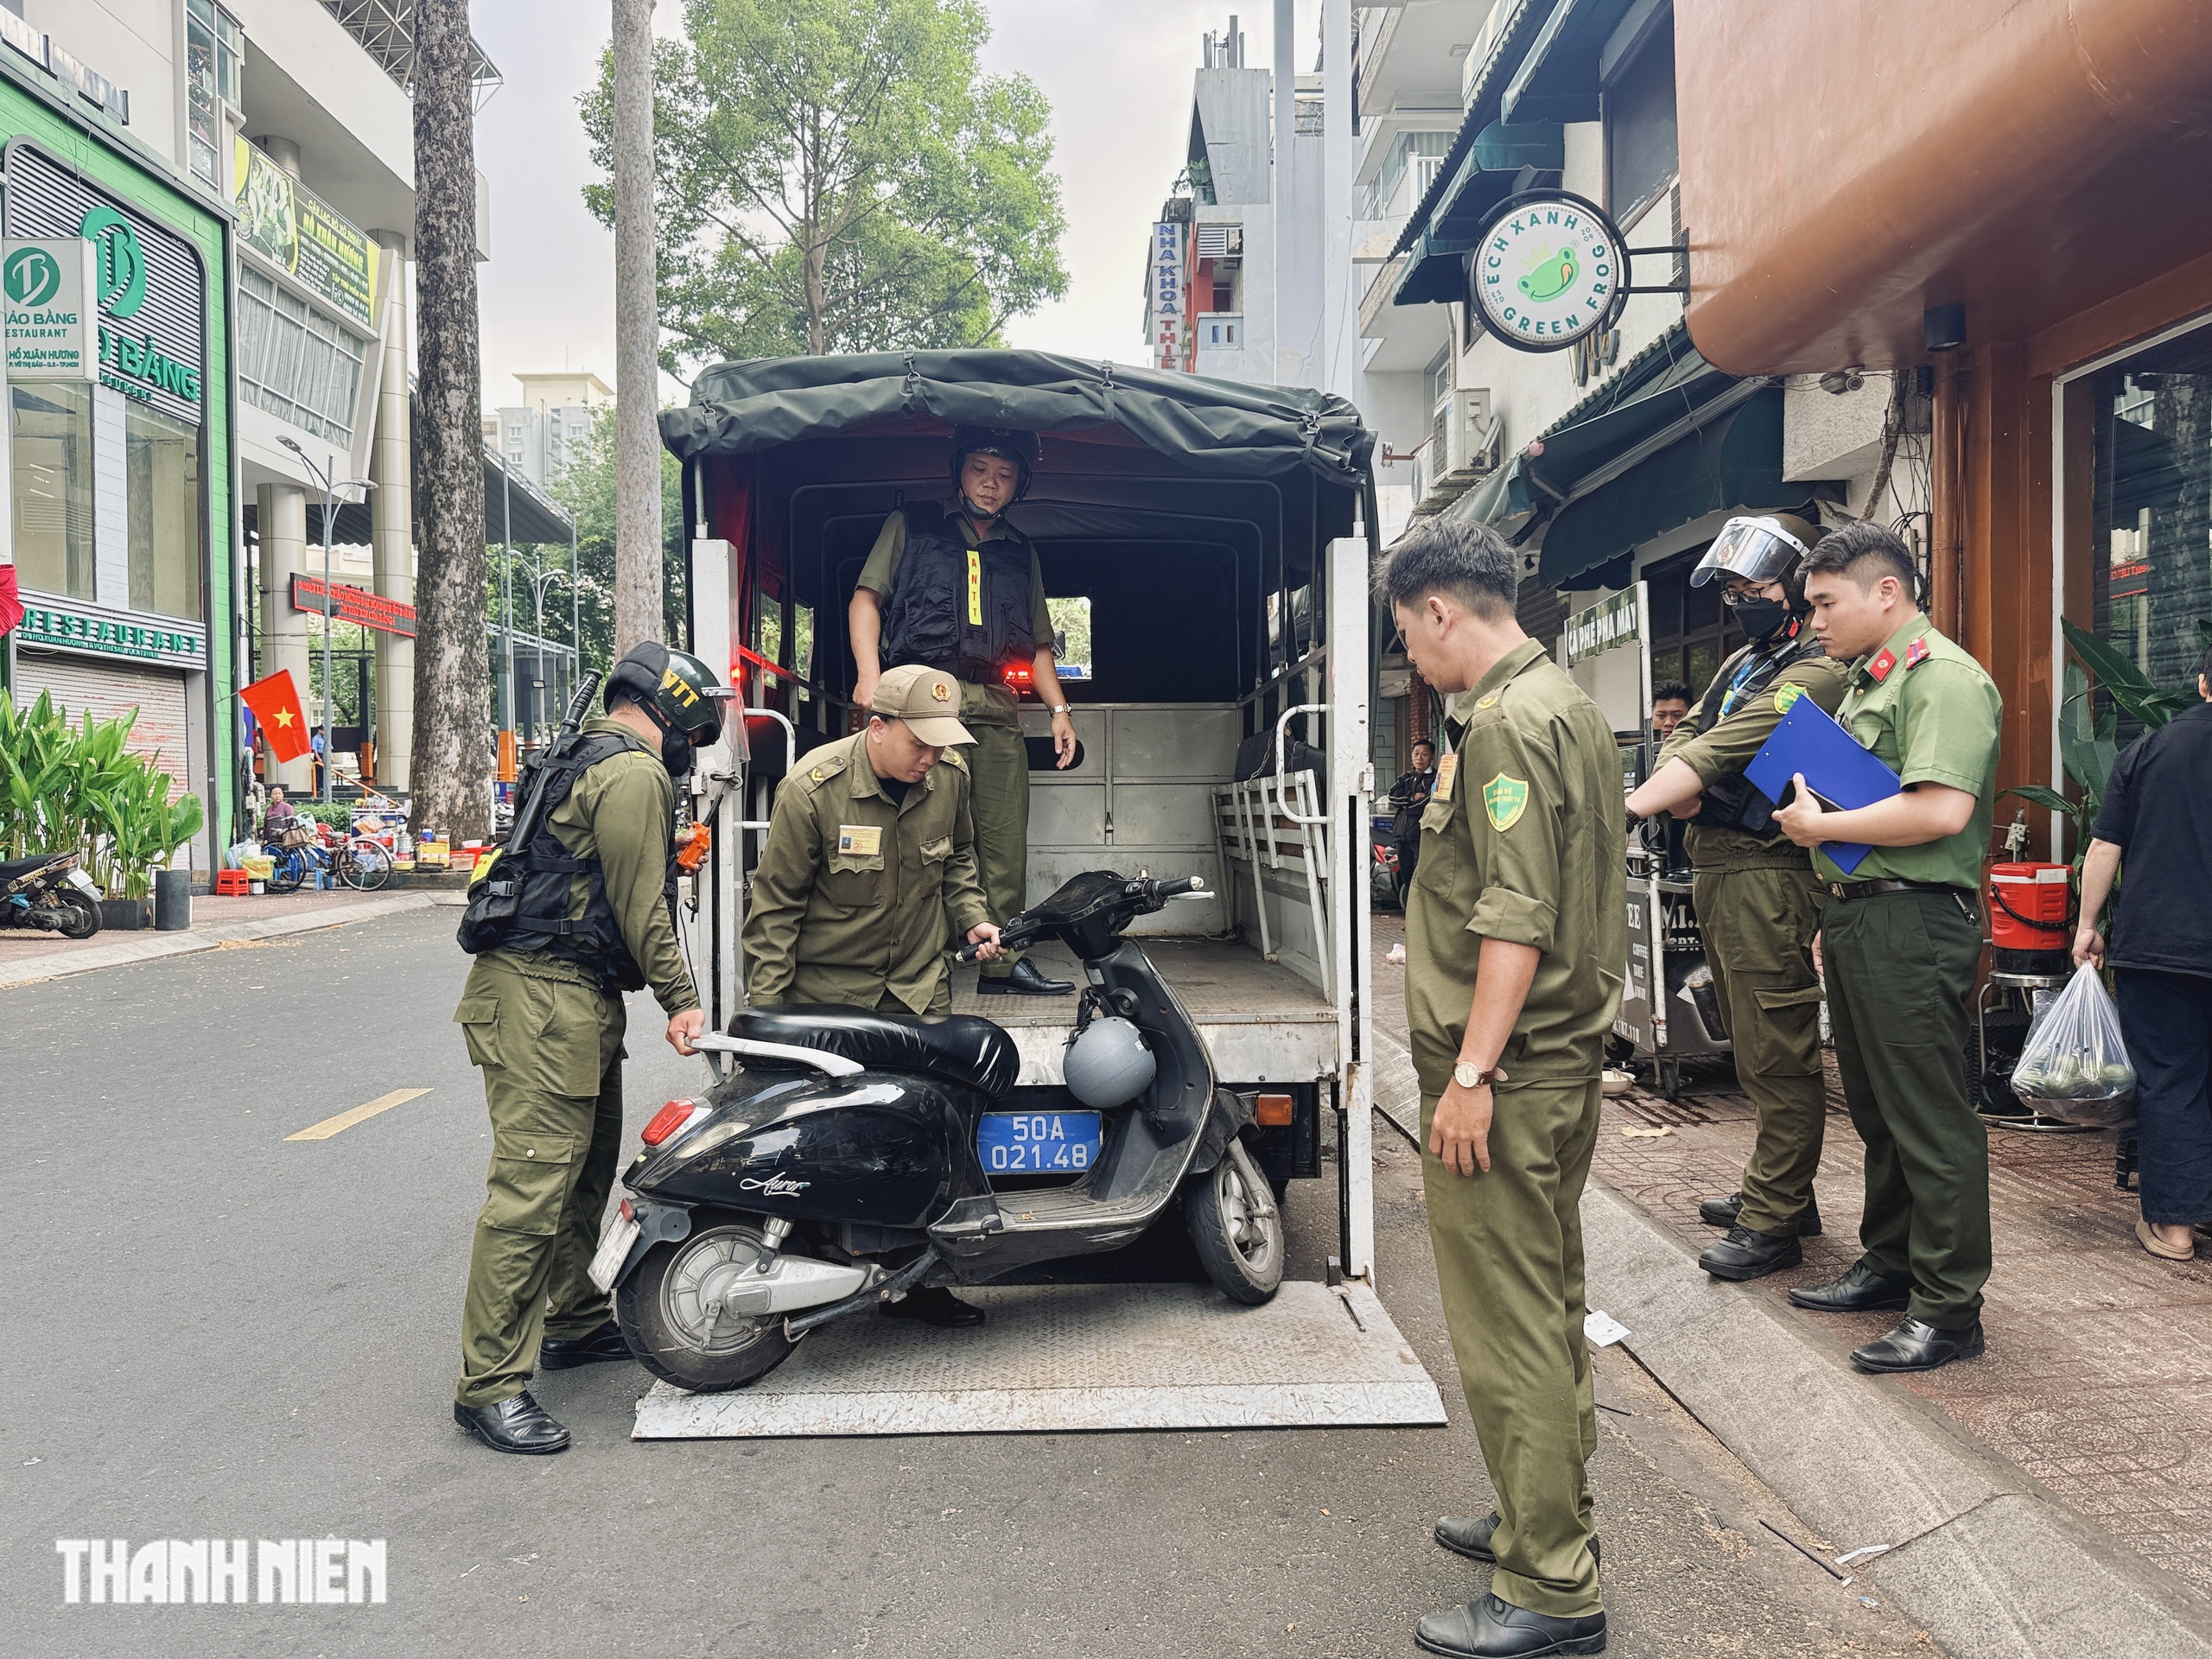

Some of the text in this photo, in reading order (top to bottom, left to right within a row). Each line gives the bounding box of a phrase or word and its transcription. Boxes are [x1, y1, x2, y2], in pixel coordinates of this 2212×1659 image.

[1510, 210, 1579, 236] XANH
[1585, 244, 1610, 310] FROG
[1159, 224, 1177, 370] NHA KHOA THIÊ
[5, 328, 67, 338] ESTAURANT
[1503, 306, 1580, 335] GREEN
[22, 607, 200, 655] RESTAURANT
[1568, 598, 1637, 657] CÀ PHÊ PHA MÁY
[660, 667, 701, 709] NTT
[1632, 943, 1649, 960] COFFEE
[1012, 1115, 1065, 1141] 50A
[991, 1143, 1088, 1170] 021.48
